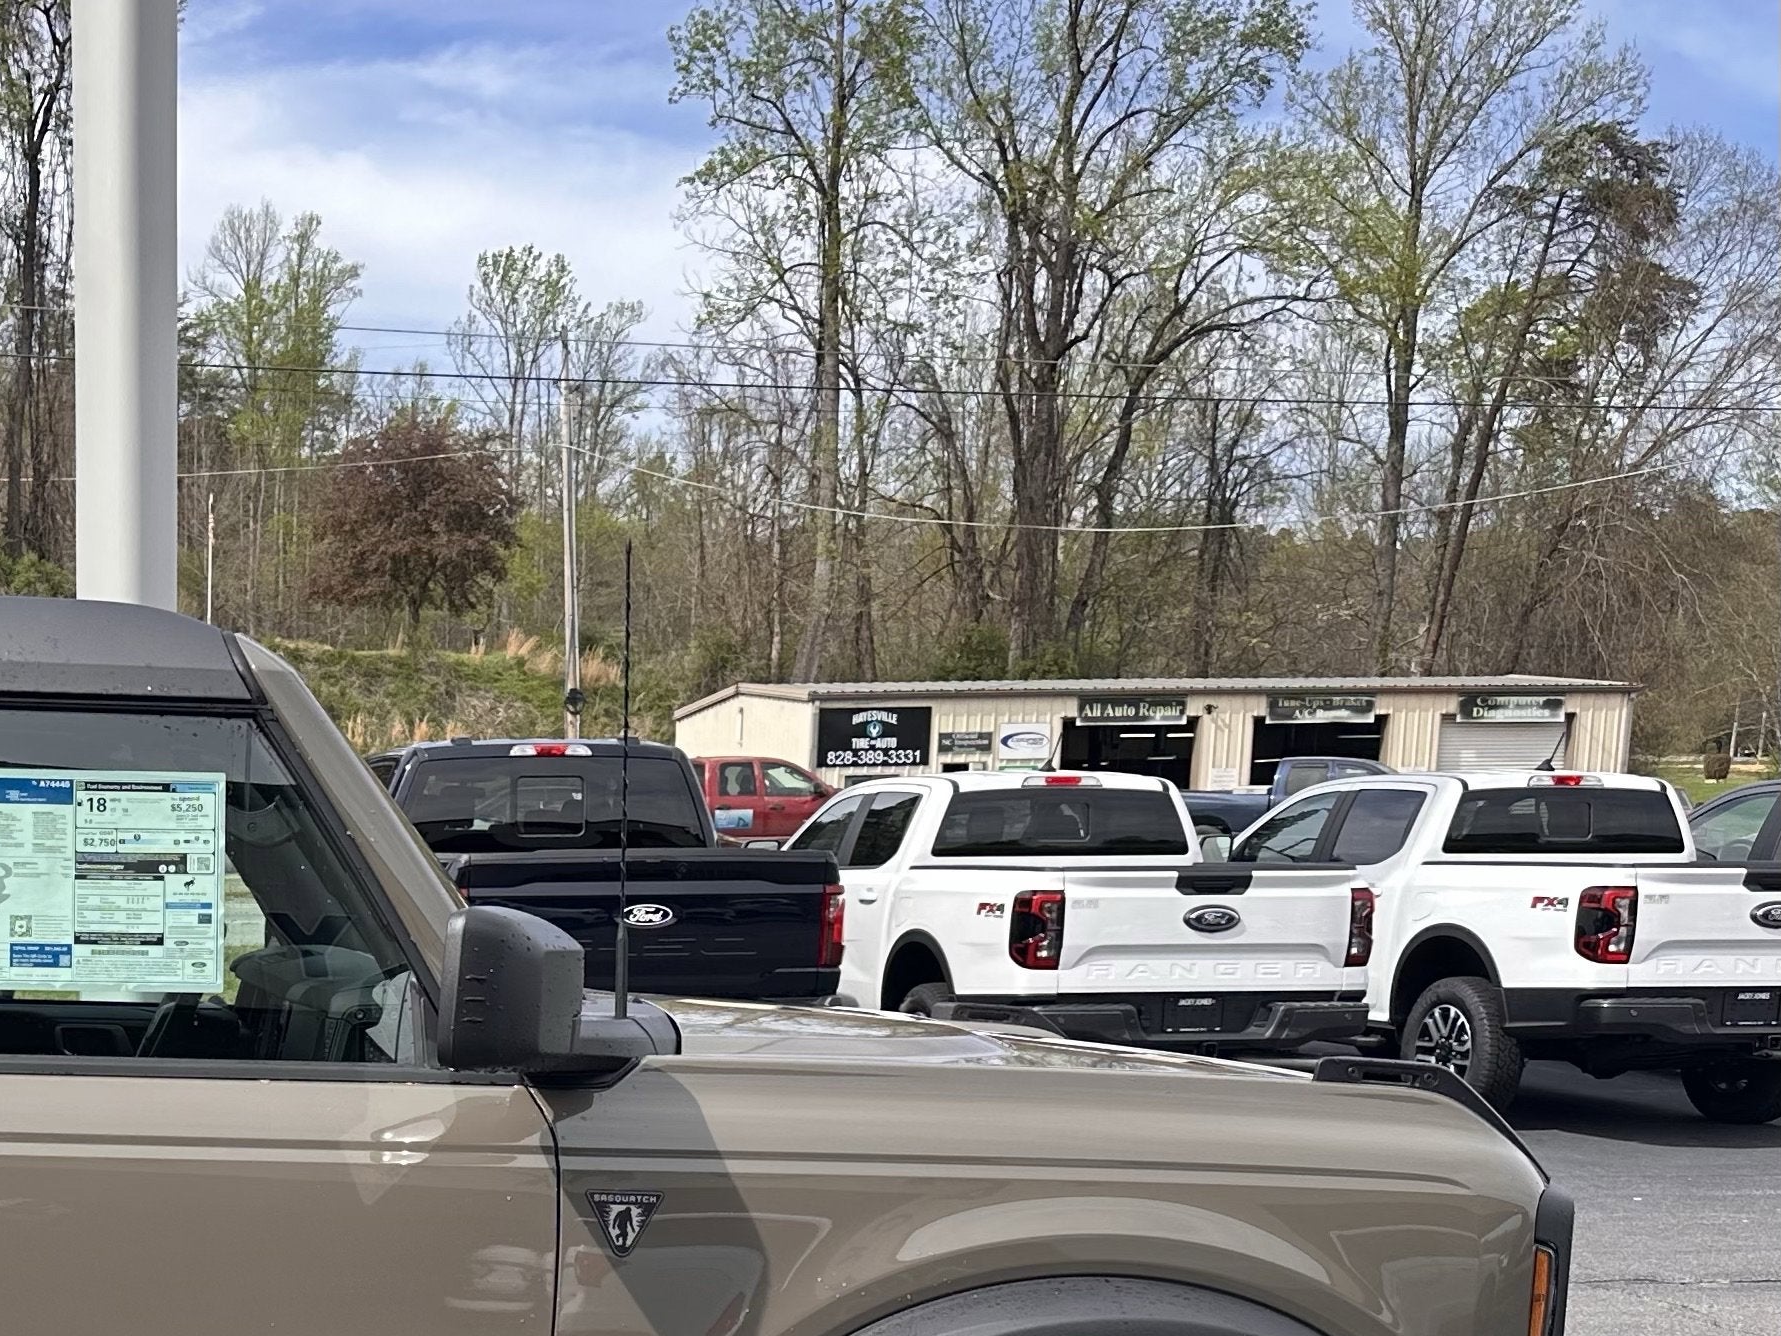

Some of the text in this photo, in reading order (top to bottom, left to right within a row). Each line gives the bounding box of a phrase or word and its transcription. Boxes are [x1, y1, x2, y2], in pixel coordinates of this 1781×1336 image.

[1477, 696, 1543, 708] Computer
[852, 710, 898, 725] HAYESVILLE
[1082, 702, 1183, 721] All Auto Repair
[1472, 706, 1550, 719] Diagnostics
[851, 737, 871, 749] TIRE
[876, 737, 897, 748] AUTO
[826, 749, 921, 765] 828-389-3331
[86, 797, 107, 813] 18
[170, 803, 204, 813] $5,250
[83, 838, 116, 848] $2,750
[977, 902, 1006, 916] FX4
[1531, 896, 1569, 909] FX4
[628, 907, 663, 923] Ford
[1086, 962, 1321, 980] RANGER
[1656, 958, 1781, 974] RAN
[593, 1193, 657, 1203] SASQUATCH
